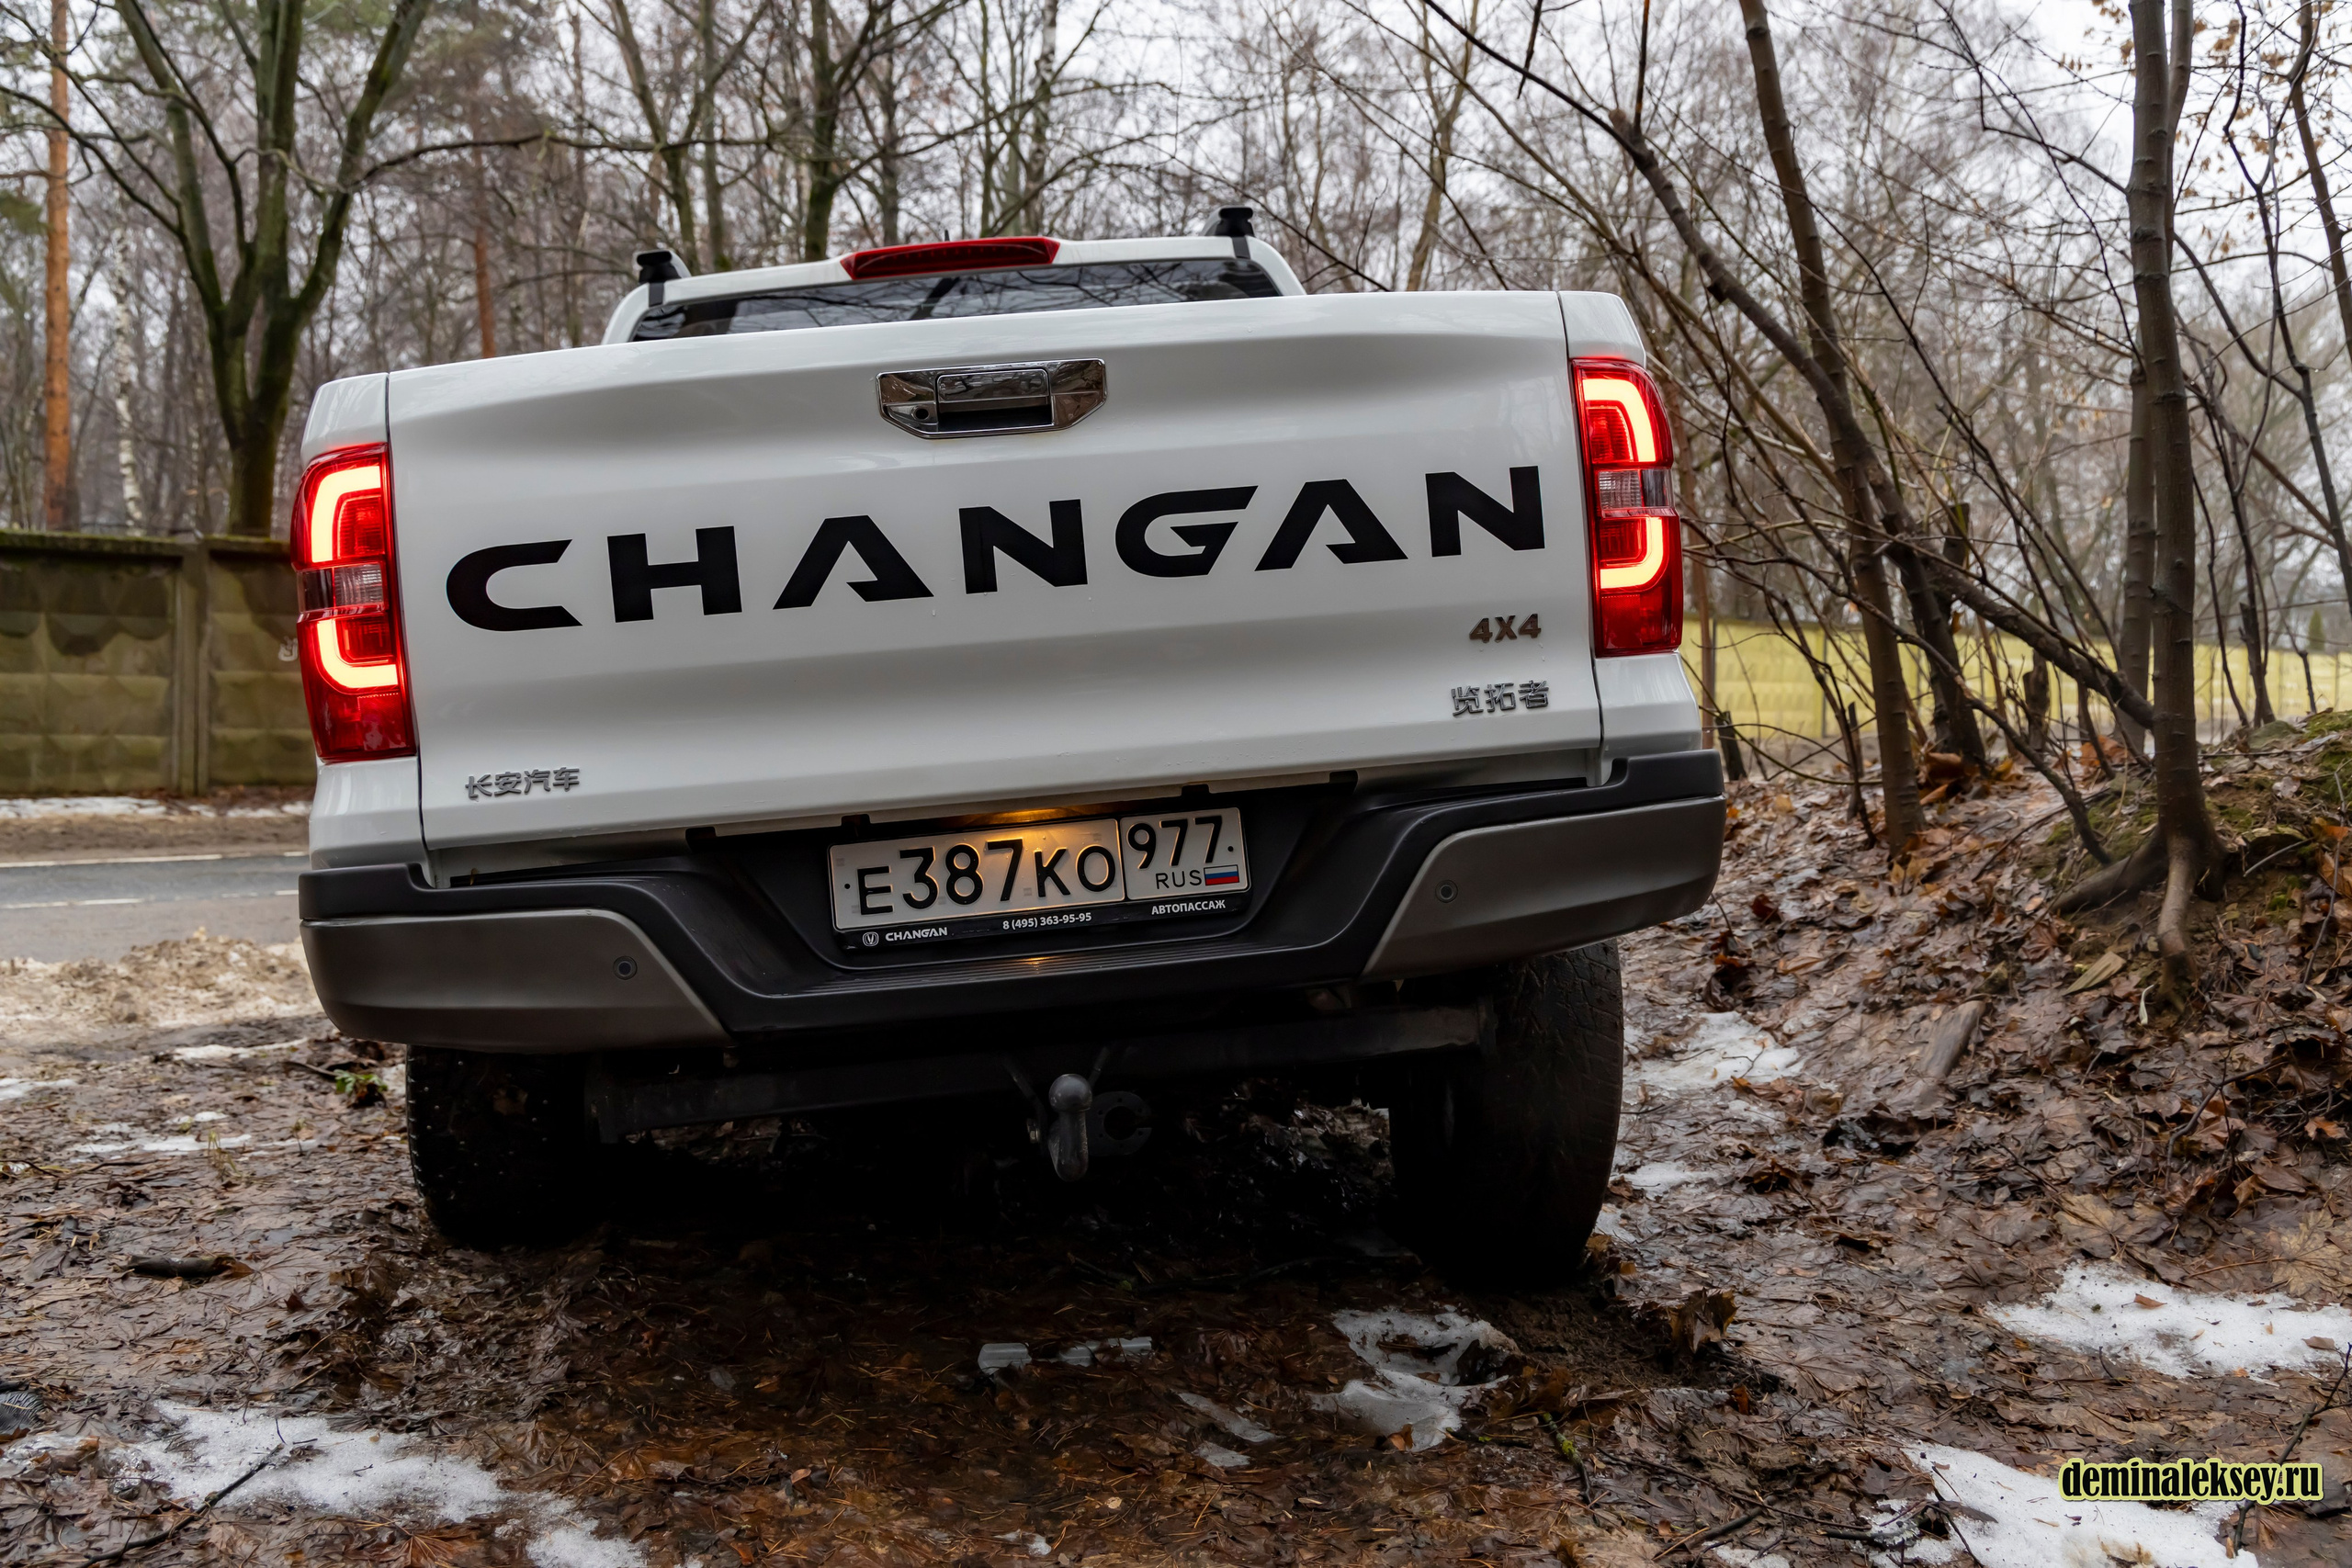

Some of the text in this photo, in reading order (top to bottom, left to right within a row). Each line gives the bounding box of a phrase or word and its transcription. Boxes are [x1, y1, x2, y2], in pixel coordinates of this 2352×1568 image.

[446, 466, 1546, 632] CHANGAN
[1469, 614, 1542, 643] 4X4
[1451, 680, 1549, 717] 览拓者
[465, 766, 580, 799] 长安汽车
[1126, 815, 1223, 870] 977
[1155, 870, 1203, 890] RUS
[1002, 912, 1092, 931] 8 (495) 363-95-95
[1151, 899, 1227, 916] АВТОПАССАЖ
[885, 927, 948, 942] CHANGAN
